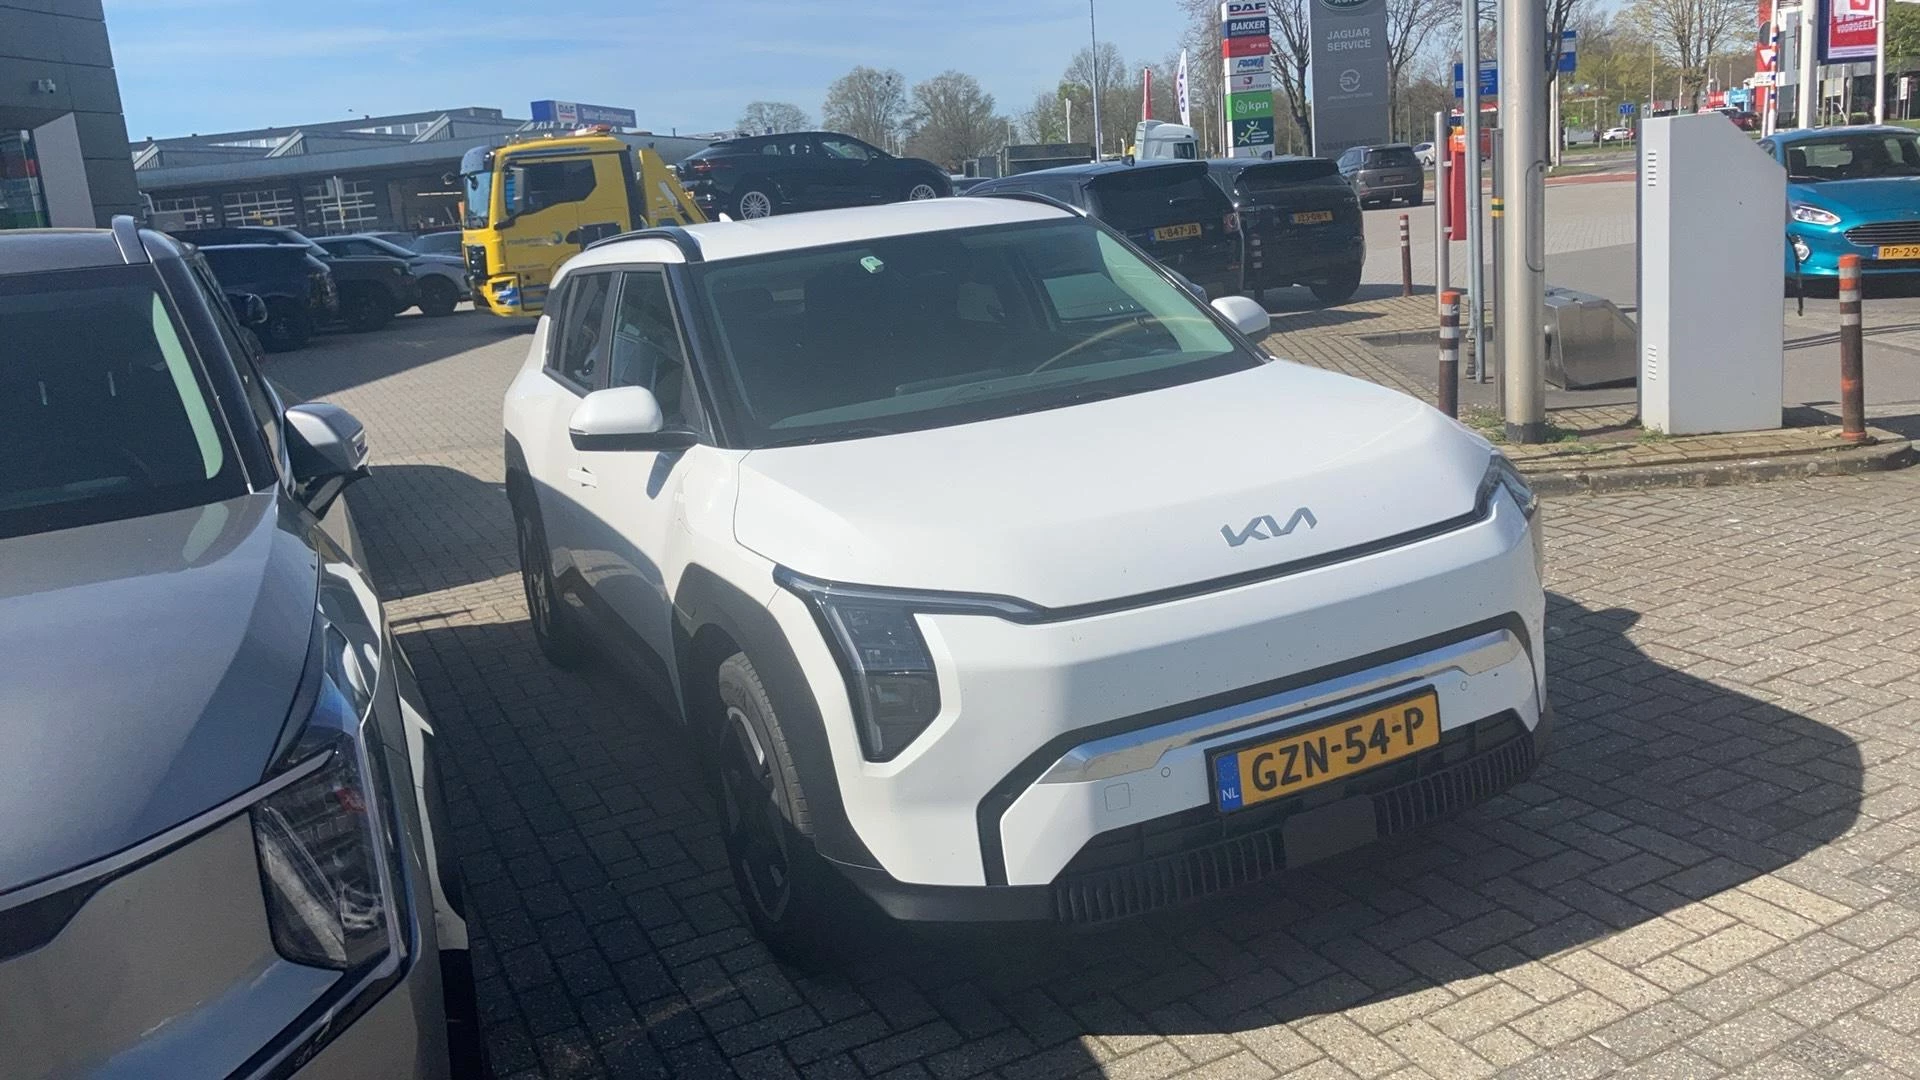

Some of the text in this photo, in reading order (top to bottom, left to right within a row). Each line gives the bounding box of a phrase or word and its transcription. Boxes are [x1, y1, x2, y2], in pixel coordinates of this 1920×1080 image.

[1229, 2, 1266, 12] DAF
[1231, 20, 1266, 31] BAKKER
[1327, 28, 1370, 40] JAGUAR
[1327, 39, 1371, 51] SERVICE
[559, 104, 575, 113] DAF
[1249, 101, 1268, 112] kpn
[1220, 507, 1317, 547] KIA
[1252, 707, 1424, 792] GZN-54-P
[1222, 788, 1239, 801] NL
